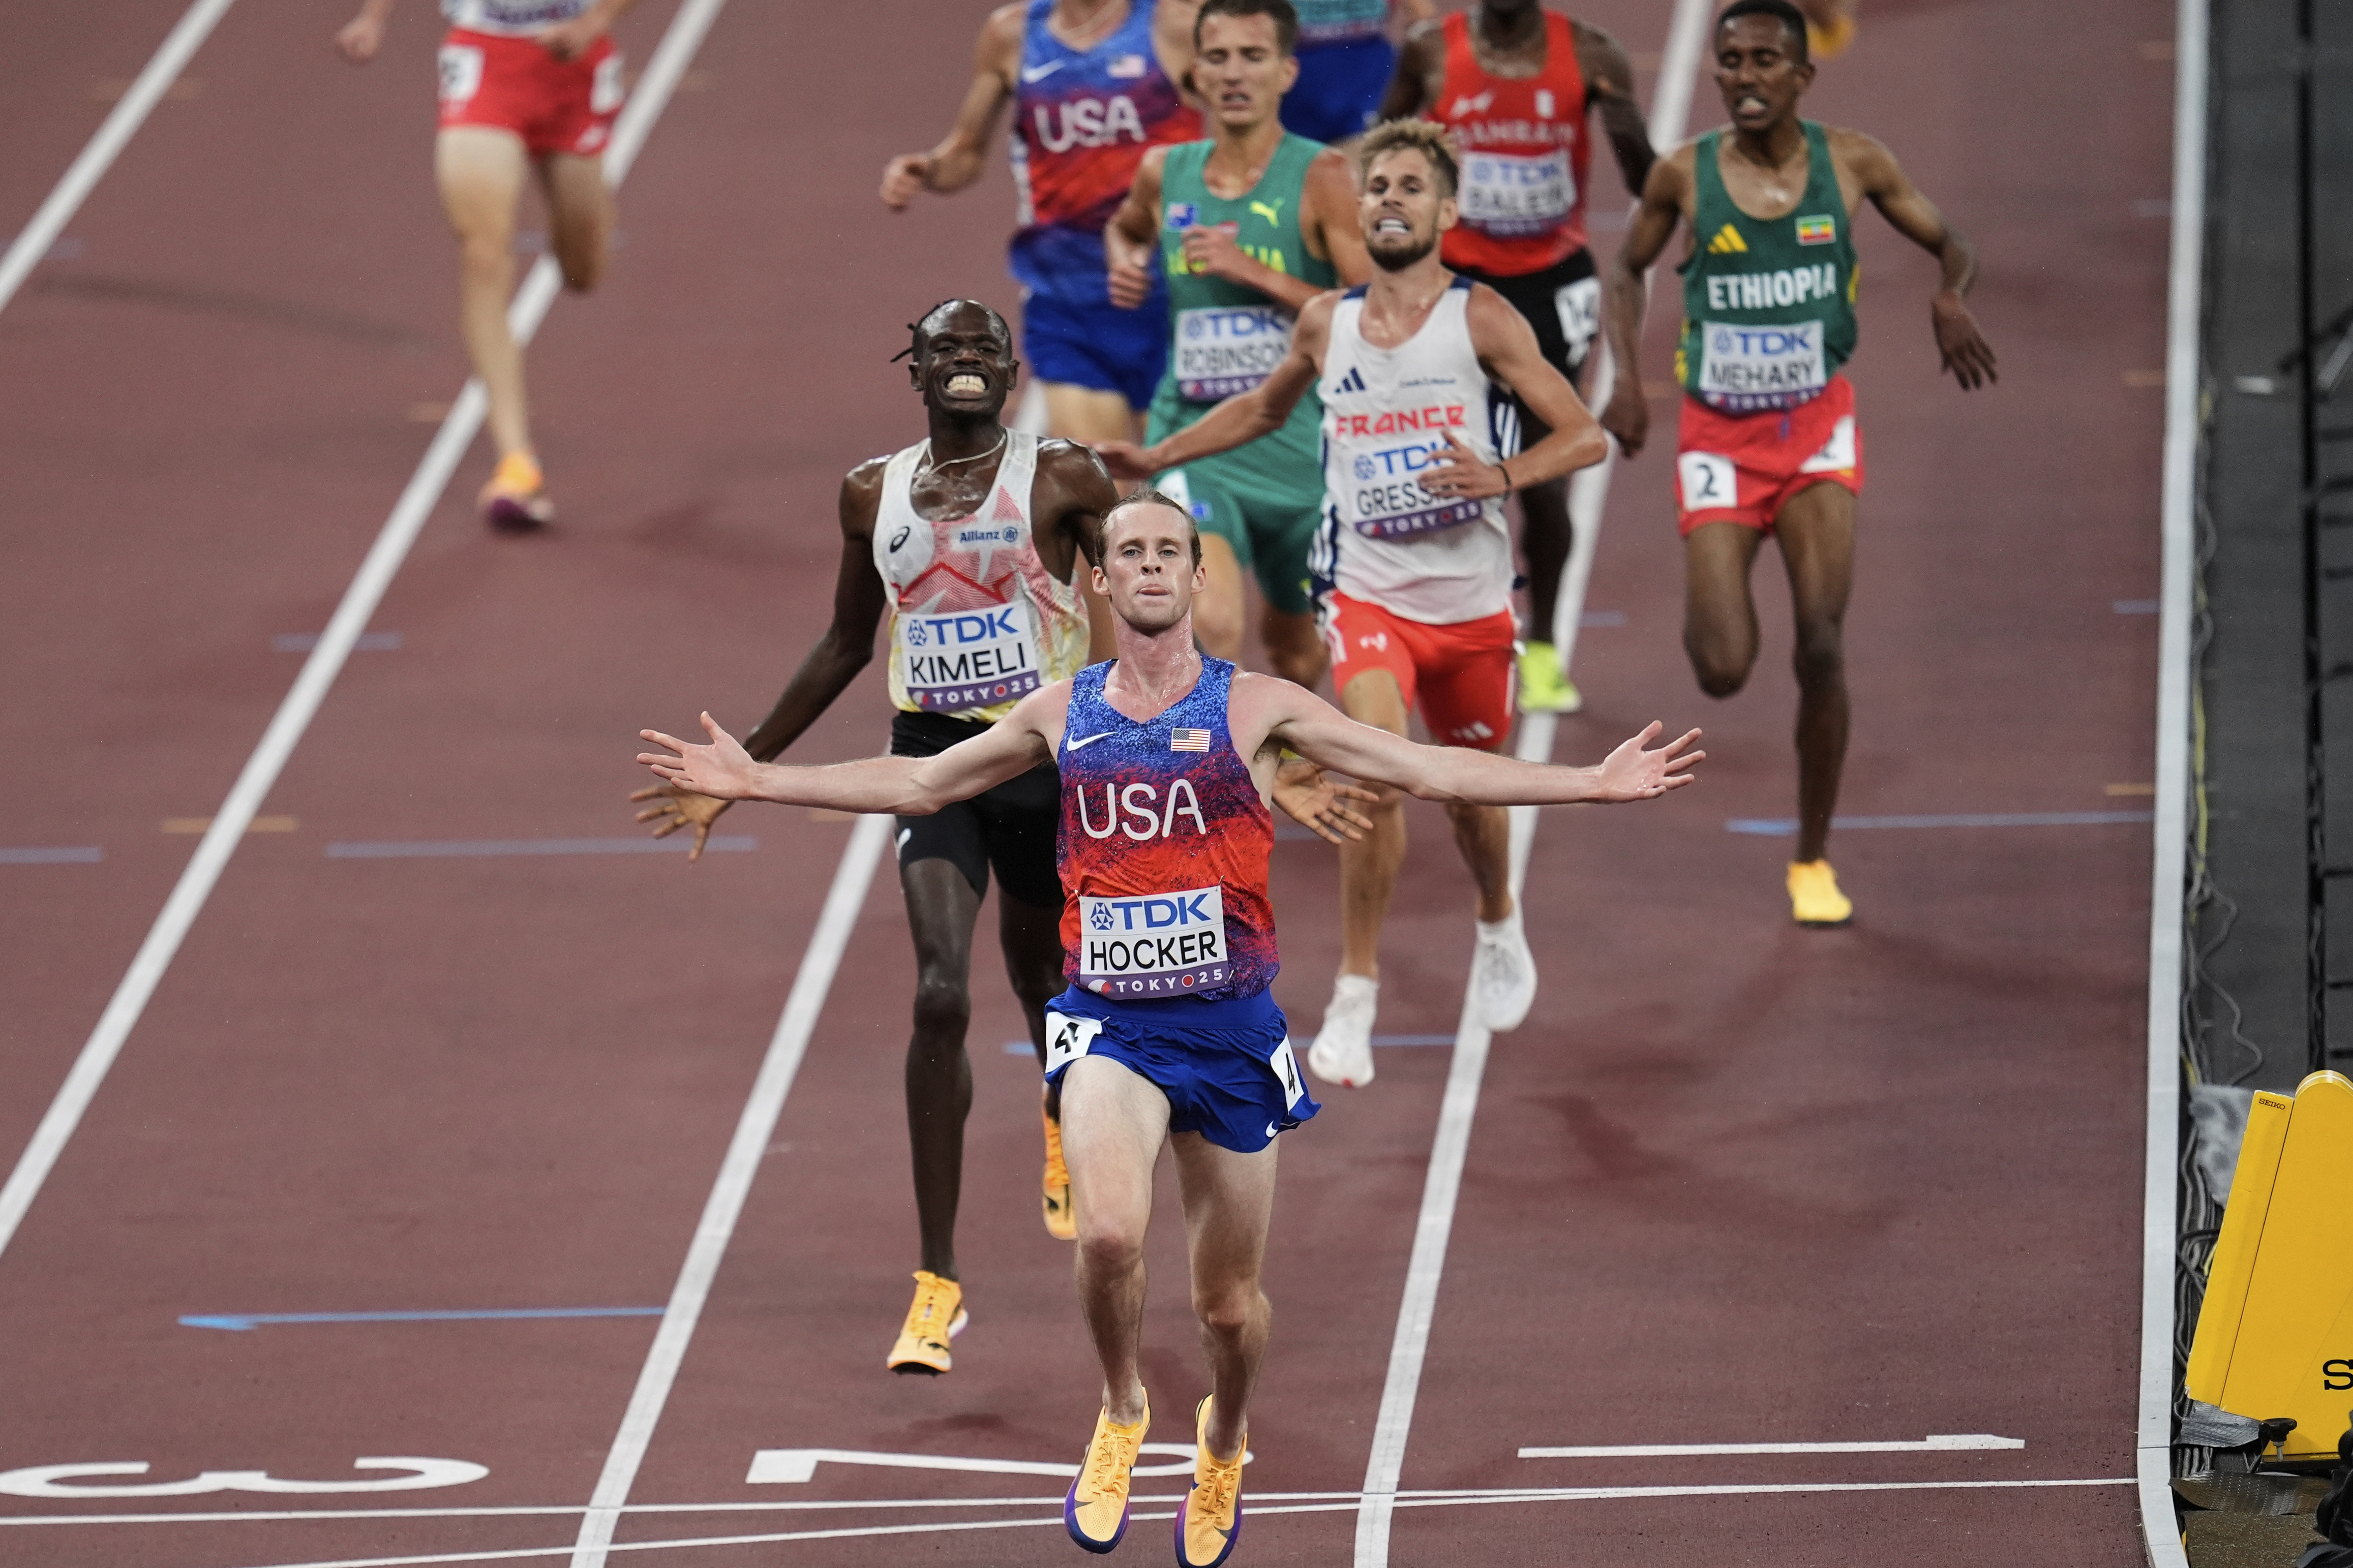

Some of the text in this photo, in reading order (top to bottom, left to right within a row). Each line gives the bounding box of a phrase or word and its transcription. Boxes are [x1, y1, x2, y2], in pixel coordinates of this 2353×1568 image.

[1034, 96, 1145, 153] USA
[1706, 262, 1837, 311] ETHIOPIA
[1207, 312, 1286, 336] TDK
[1735, 328, 1811, 355] TDK
[1710, 357, 1816, 390] MEHARY
[1336, 405, 1465, 440] FRANCE
[1697, 463, 1718, 500] 2
[959, 530, 1000, 542] Allianz
[925, 608, 1018, 645] TDK
[910, 642, 1026, 685] KIMELI
[1077, 778, 1206, 841] USA
[1112, 893, 1212, 930] TDK
[1091, 931, 1218, 971] HOCKER
[1055, 1022, 1081, 1054] 4
[1285, 1052, 1296, 1097] 4
[2258, 1098, 2286, 1111] SEIKO
